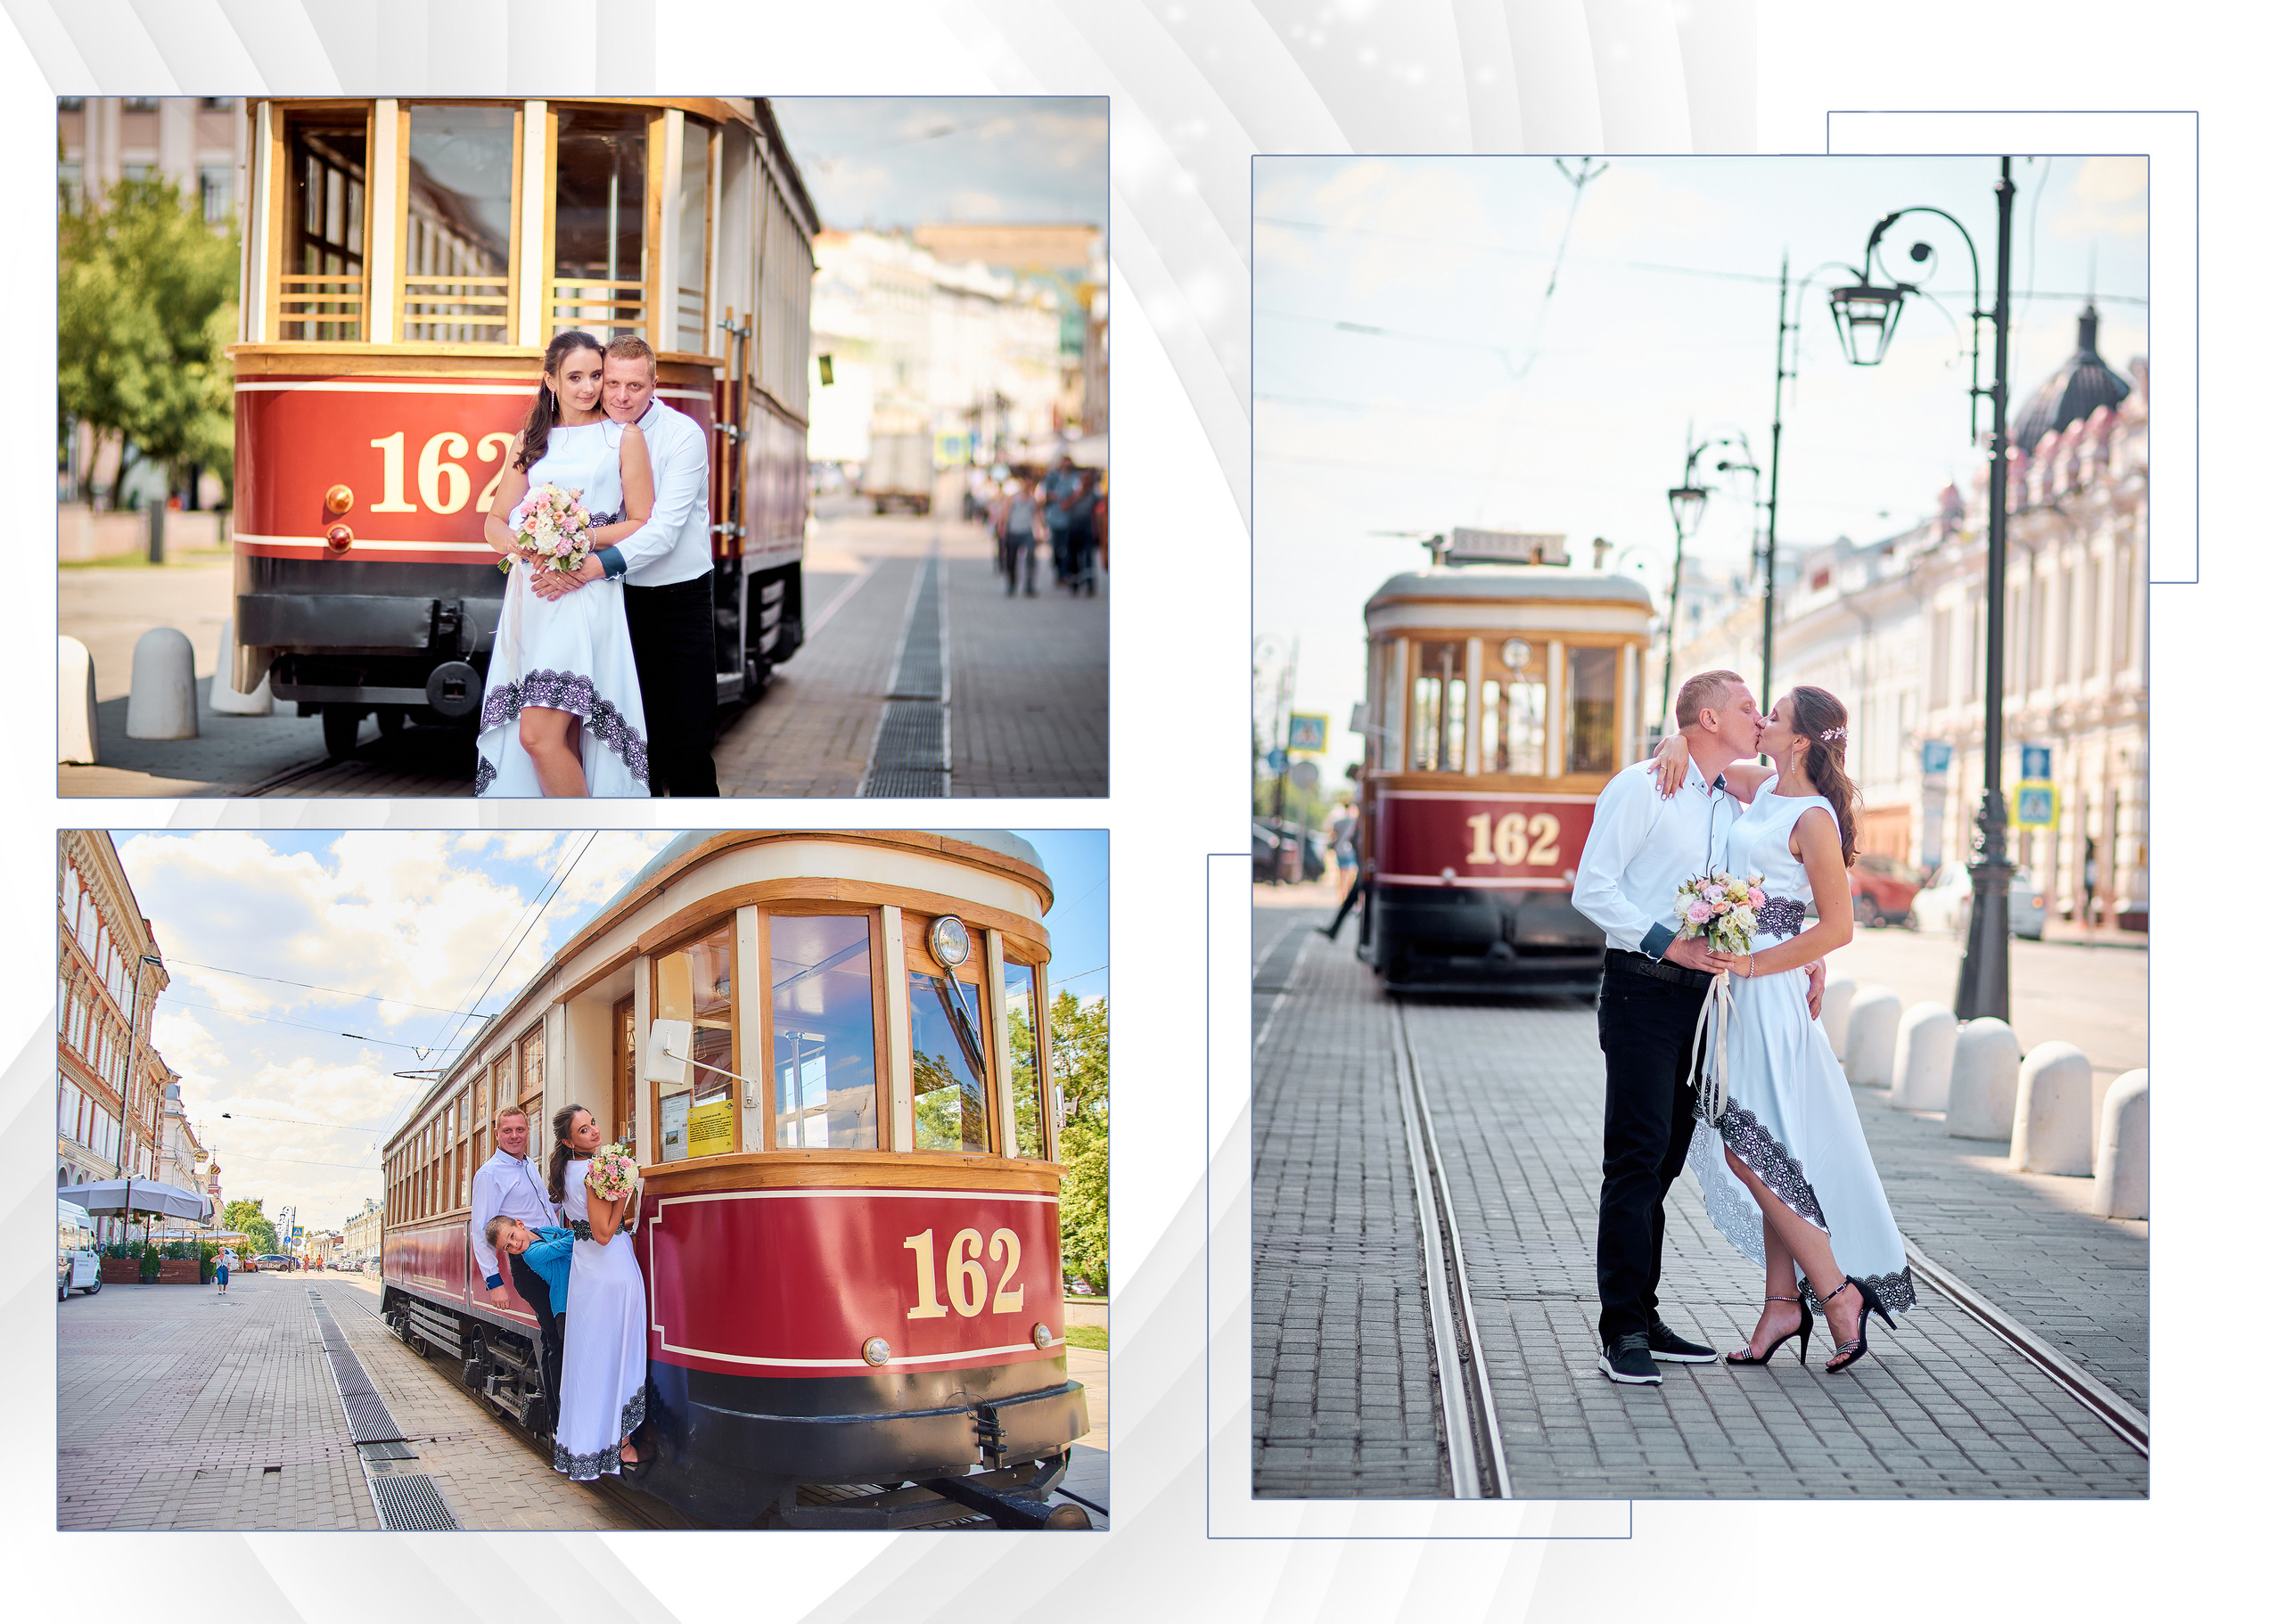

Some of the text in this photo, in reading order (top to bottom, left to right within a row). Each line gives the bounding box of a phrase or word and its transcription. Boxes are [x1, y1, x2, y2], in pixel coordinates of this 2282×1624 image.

[370, 431, 515, 514] 162
[1465, 812, 1561, 866] 162
[903, 1227, 1024, 1319] 162
